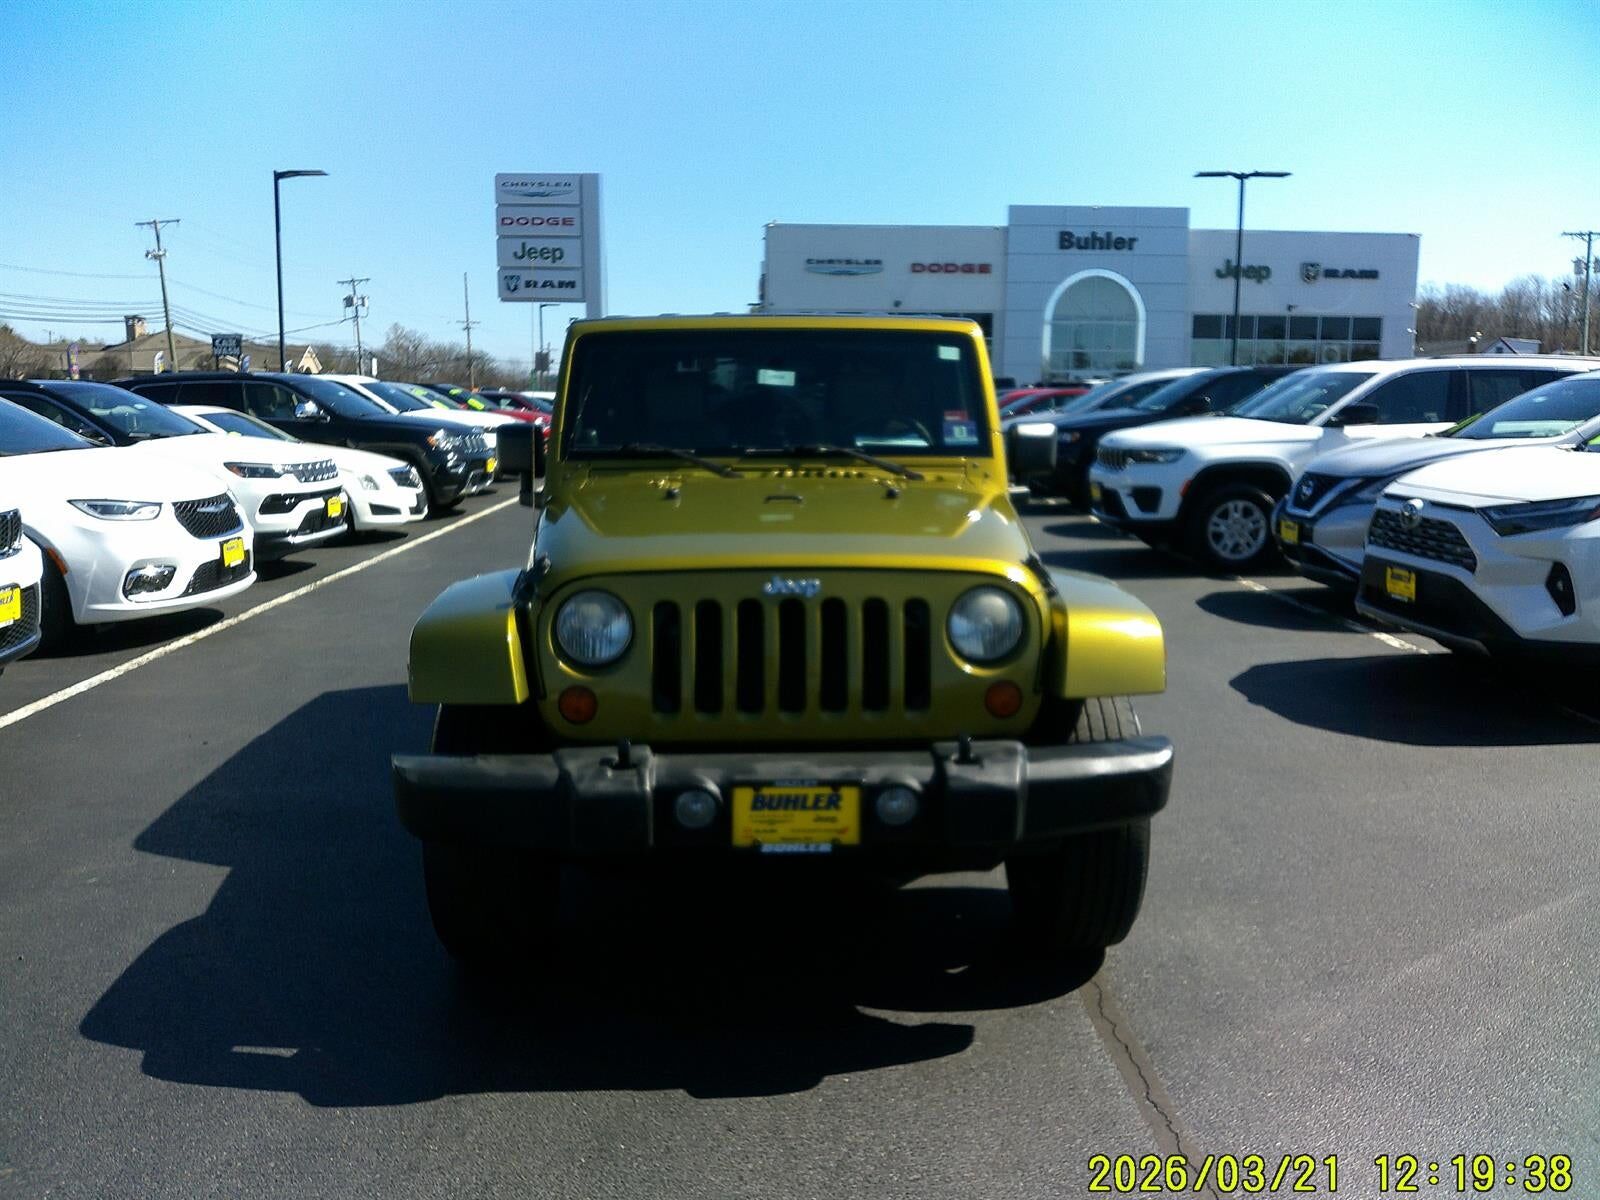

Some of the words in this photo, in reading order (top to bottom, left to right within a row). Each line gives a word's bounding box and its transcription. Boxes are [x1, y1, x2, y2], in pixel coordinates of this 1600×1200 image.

[500, 216, 575, 226] DODGE
[1058, 230, 1139, 250] Buhler
[513, 241, 564, 263] Jeep
[805, 258, 883, 266] CHRYSLER
[910, 262, 992, 274] DODGE
[1323, 268, 1379, 279] RAM
[524, 279, 577, 290] RAM
[763, 576, 821, 598] Jeep
[751, 792, 842, 810] BUHLER
